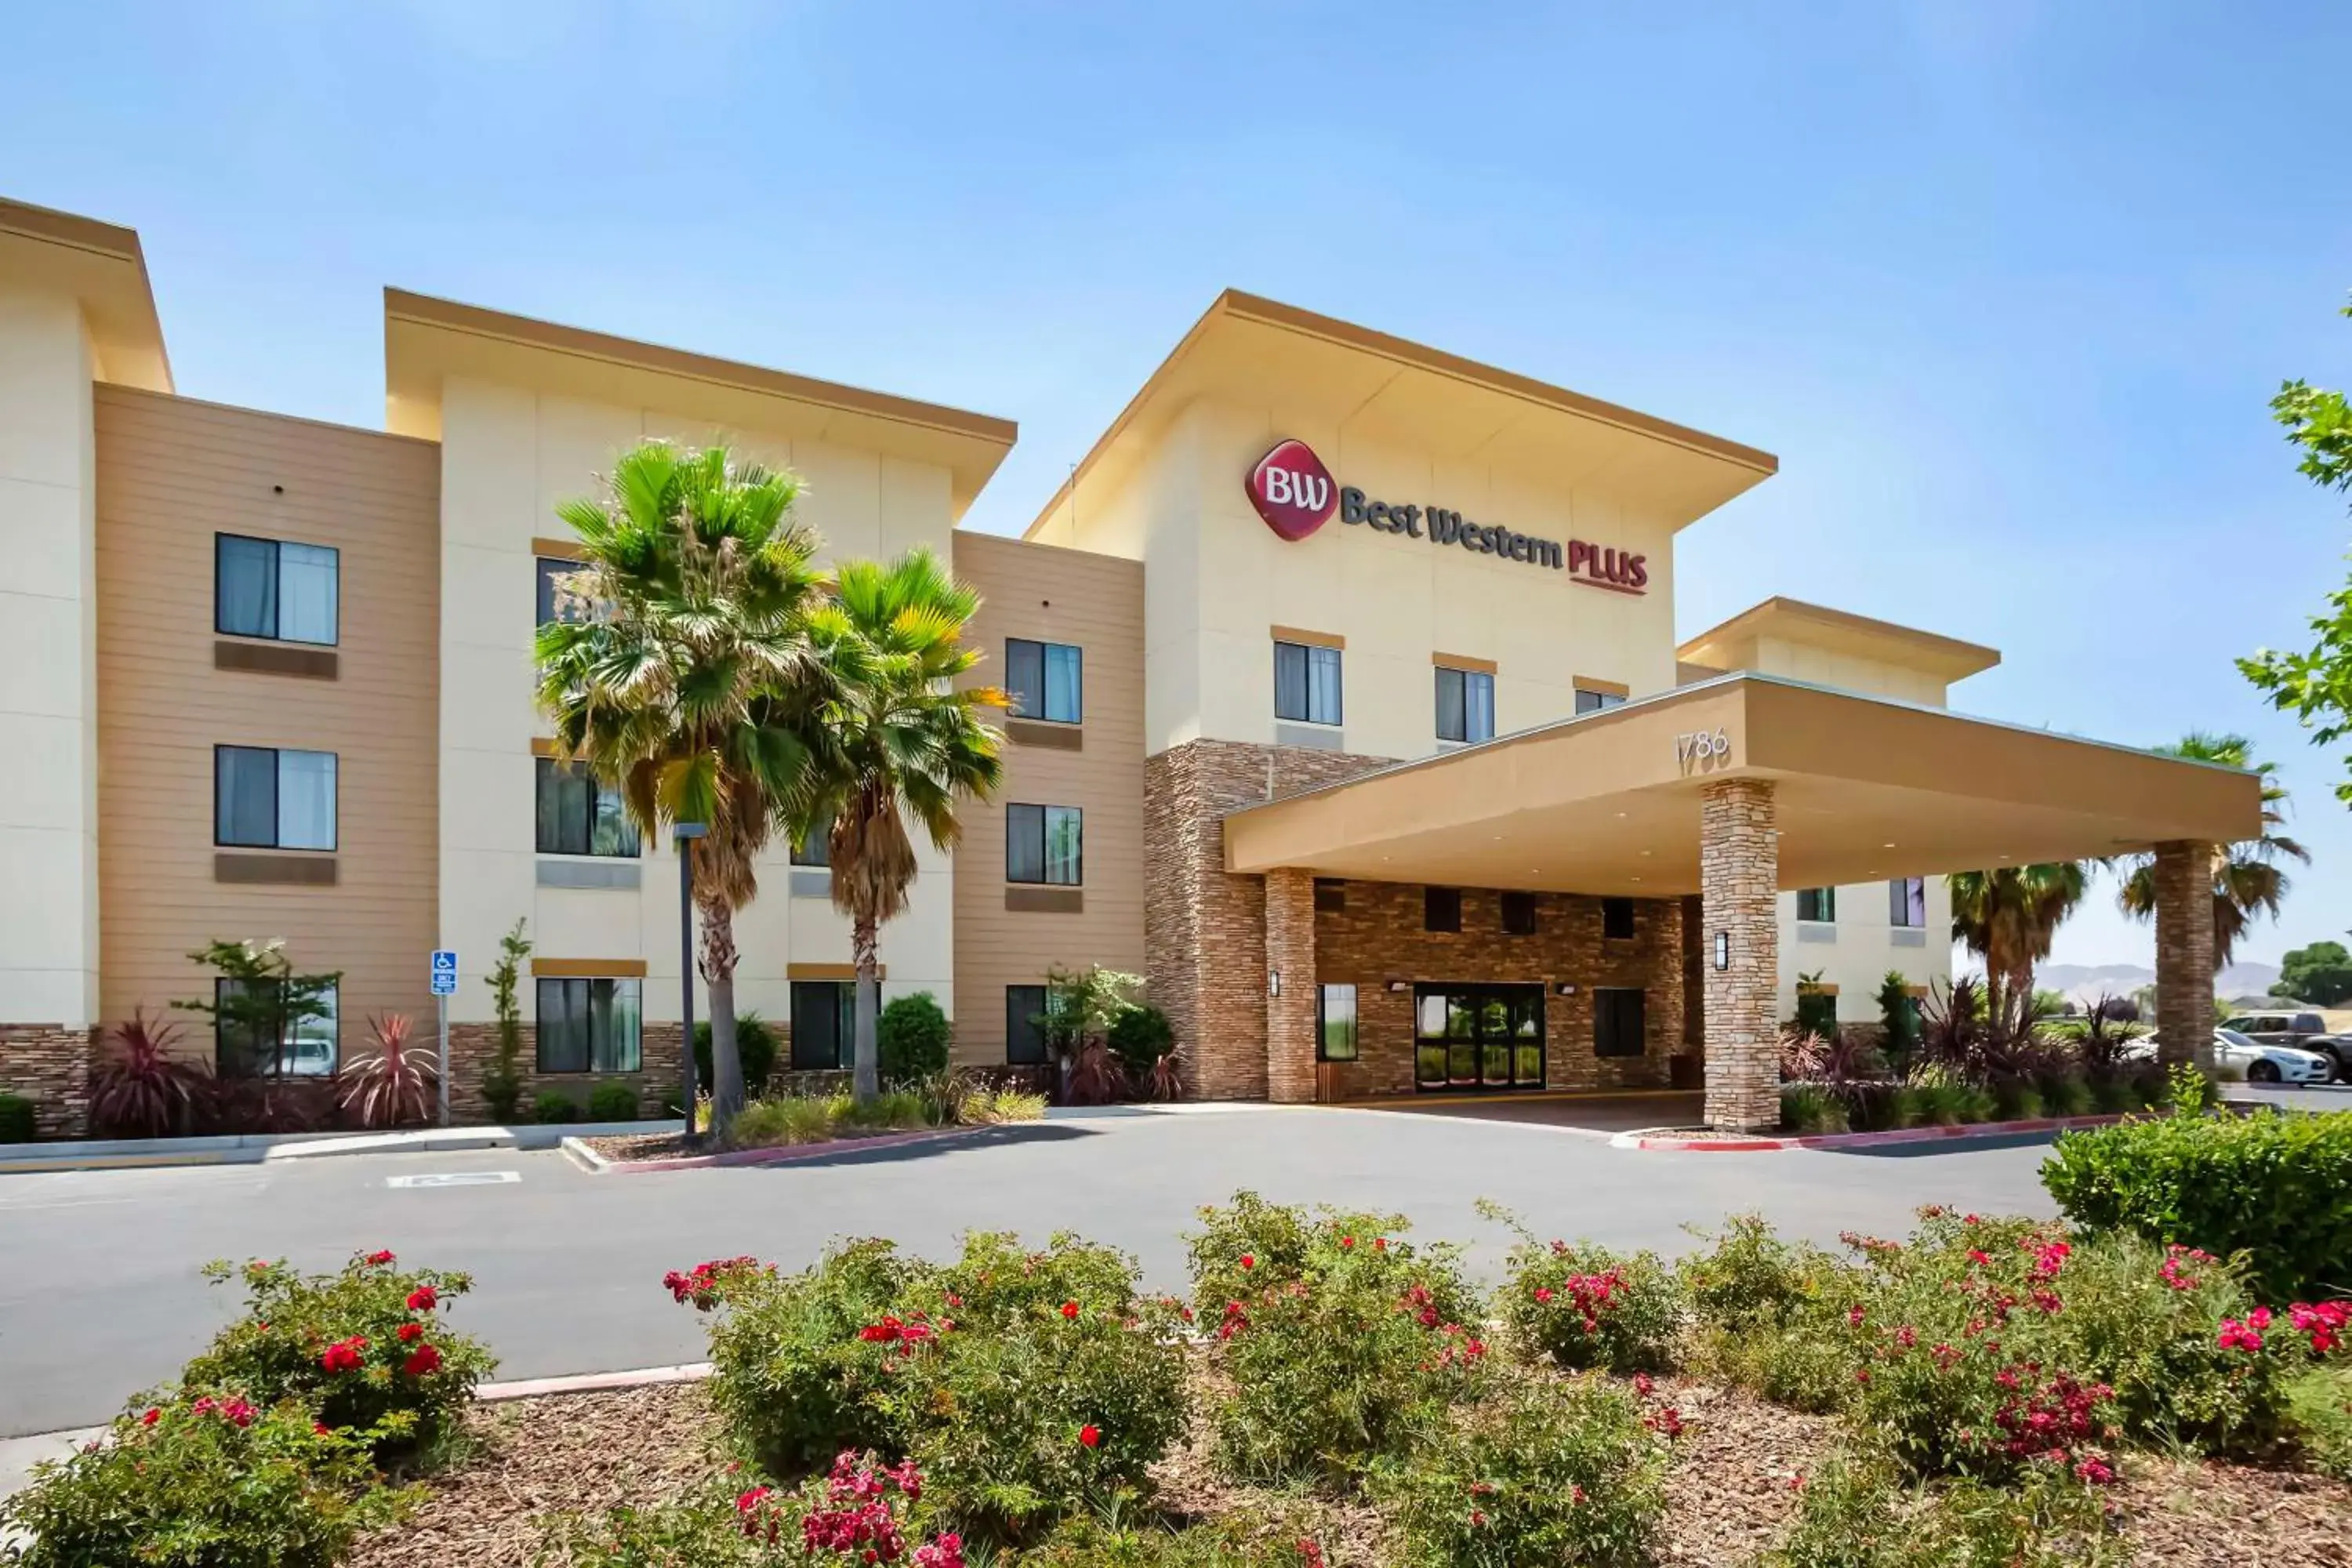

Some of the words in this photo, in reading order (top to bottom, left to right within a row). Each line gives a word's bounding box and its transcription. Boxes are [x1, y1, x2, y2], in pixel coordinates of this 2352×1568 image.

[1265, 466, 1329, 511] BW
[1340, 486, 1423, 538] Best
[1425, 505, 1563, 569] Western
[1568, 539, 1648, 587] PLUS
